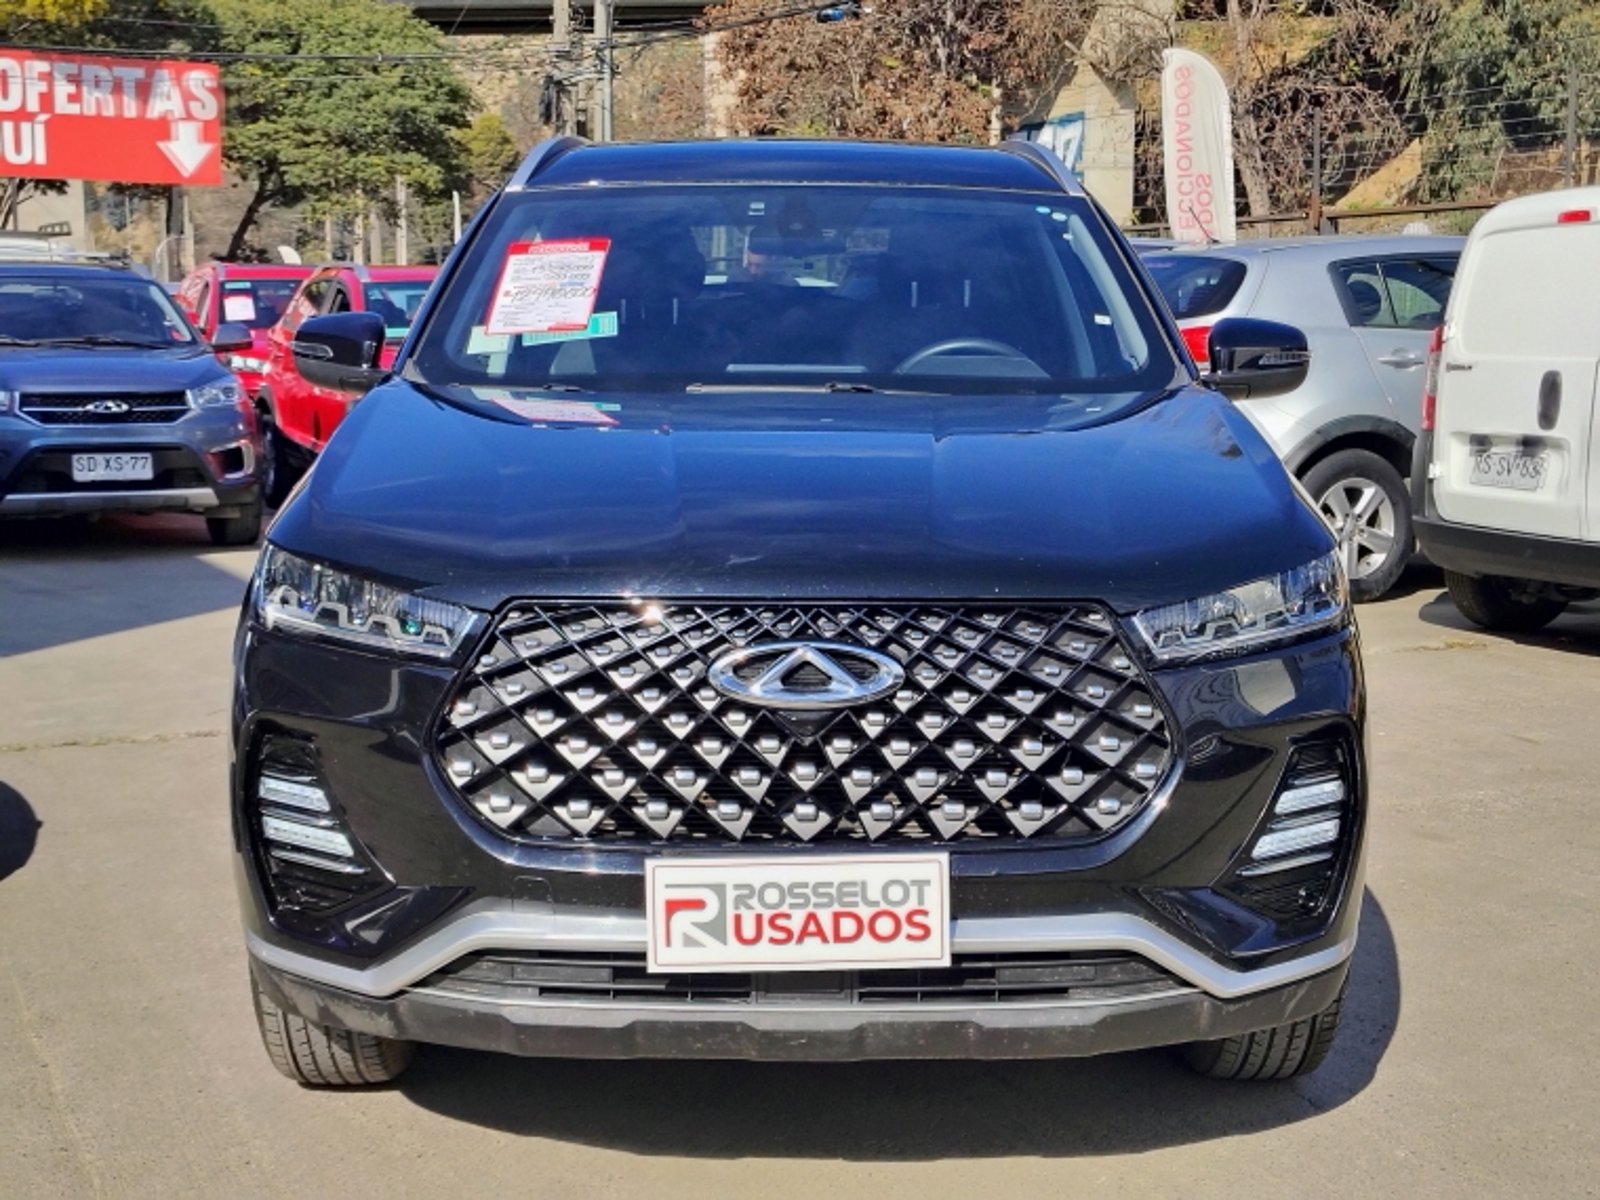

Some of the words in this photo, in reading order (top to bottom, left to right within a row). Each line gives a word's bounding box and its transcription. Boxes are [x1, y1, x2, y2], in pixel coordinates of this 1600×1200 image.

[0, 56, 218, 120] OFERTAS
[0, 113, 51, 165] UÍ
[732, 879, 932, 911] ROSSELOT
[733, 908, 932, 946] USADOS
